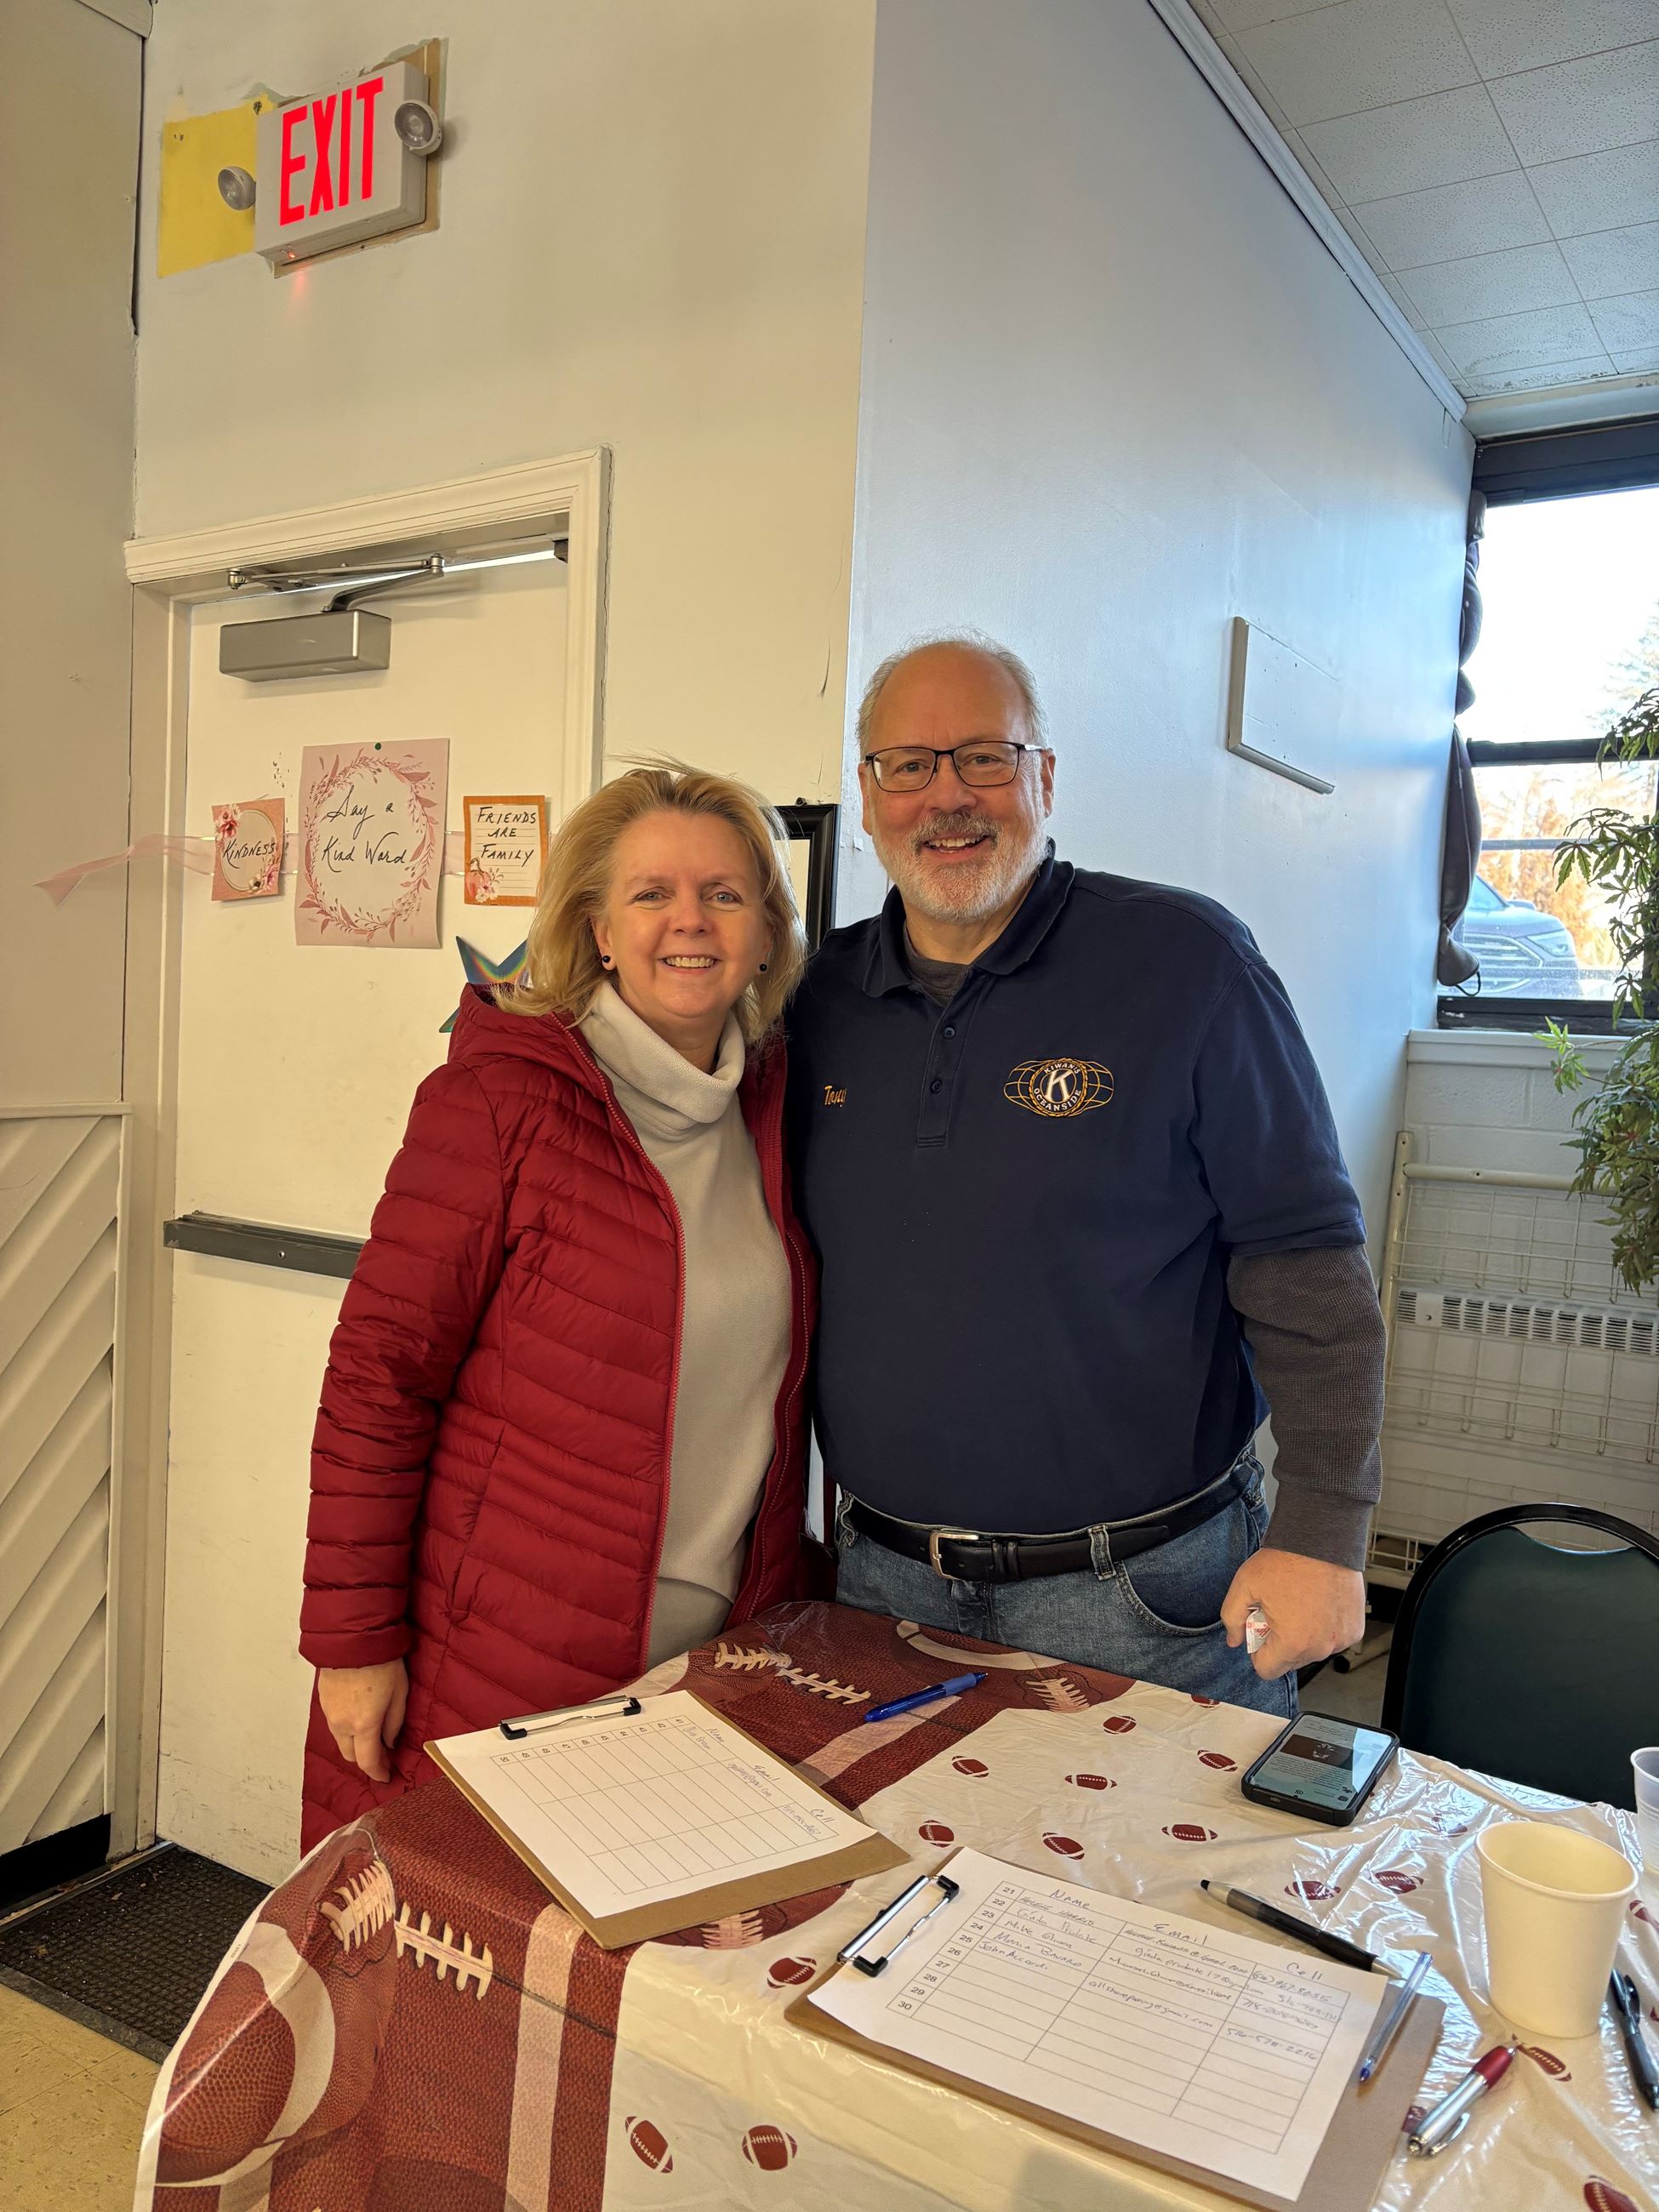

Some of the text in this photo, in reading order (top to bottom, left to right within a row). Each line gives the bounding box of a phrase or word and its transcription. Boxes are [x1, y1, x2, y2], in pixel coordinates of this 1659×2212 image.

[280, 76, 383, 226] EXIT
[327, 784, 394, 840] Say a
[477, 807, 536, 824] FRIENDS
[487, 826, 517, 839] ARE
[322, 832, 408, 872] Kind Word
[481, 844, 534, 867] FAMILY
[1044, 1063, 1080, 1074] KIWANIS
[1045, 1069, 1074, 1103] K
[1034, 1087, 1081, 1111] OCEANSIDE
[992, 1898, 1006, 1907] 22
[982, 1910, 995, 1918] 23
[971, 1922, 983, 1930] 24
[960, 1935, 972, 1943] 25
[948, 1947, 961, 1956] 26
[979, 1941, 1005, 1954] John
[936, 1960, 950, 1969] 27
[1286, 1962, 1323, 1981] Cell
[924, 1974, 938, 1982] 28
[910, 1987, 925, 1996] 29
[898, 2000, 912, 2010] 30
